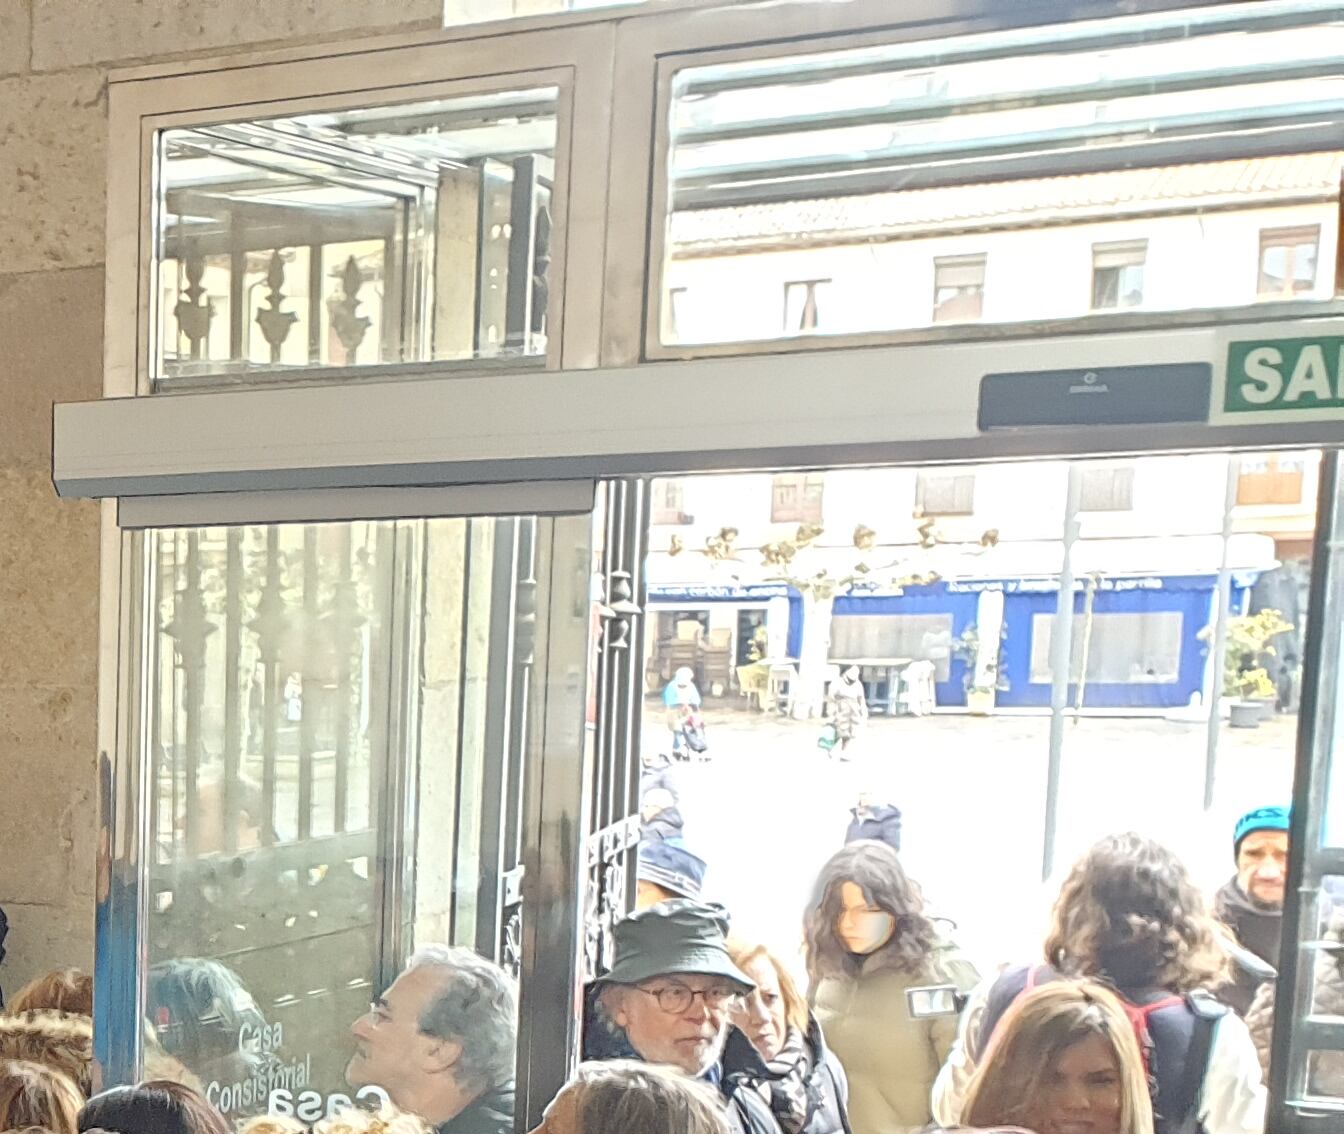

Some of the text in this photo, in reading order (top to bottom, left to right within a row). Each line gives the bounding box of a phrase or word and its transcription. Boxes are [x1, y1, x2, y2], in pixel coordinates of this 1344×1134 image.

[1241, 344, 1344, 404] SA
[238, 1021, 282, 1052] Casa
[206, 1053, 311, 1113] Consistorial
